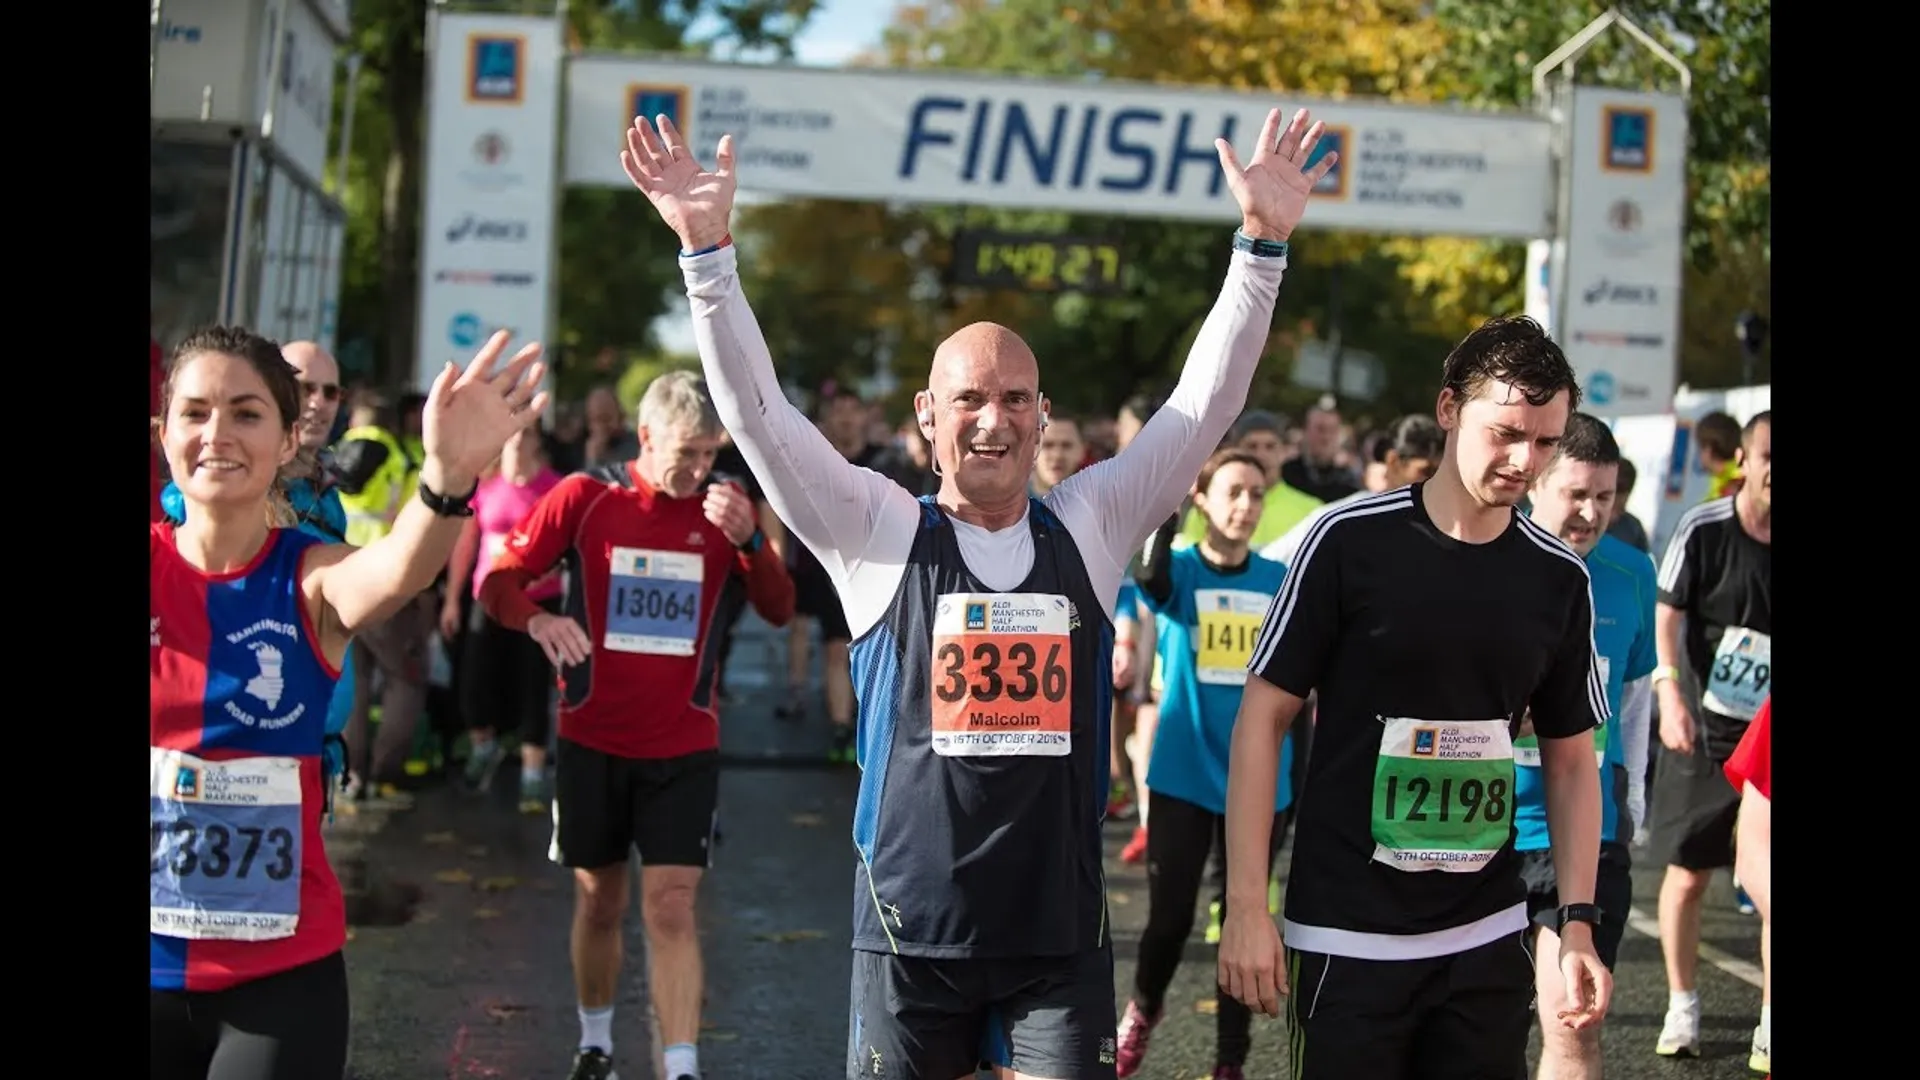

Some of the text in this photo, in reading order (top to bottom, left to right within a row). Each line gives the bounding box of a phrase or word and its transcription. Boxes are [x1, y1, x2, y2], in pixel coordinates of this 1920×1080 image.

[898, 97, 1238, 197] FINISH
[615, 587, 696, 621] 13064
[992, 609, 1045, 617] MANCHESTER
[992, 617, 1012, 625] HALF
[991, 625, 1038, 633] MARATHON
[936, 642, 1067, 703] 3336
[224, 700, 255, 726] ROAD
[970, 713, 1041, 726] Malcolm
[982, 733, 1035, 744] OCTOBER
[1440, 736, 1490, 744] MANCHESTER
[1386, 775, 1507, 823] 12198
[1420, 851, 1468, 862] OCTOBER
